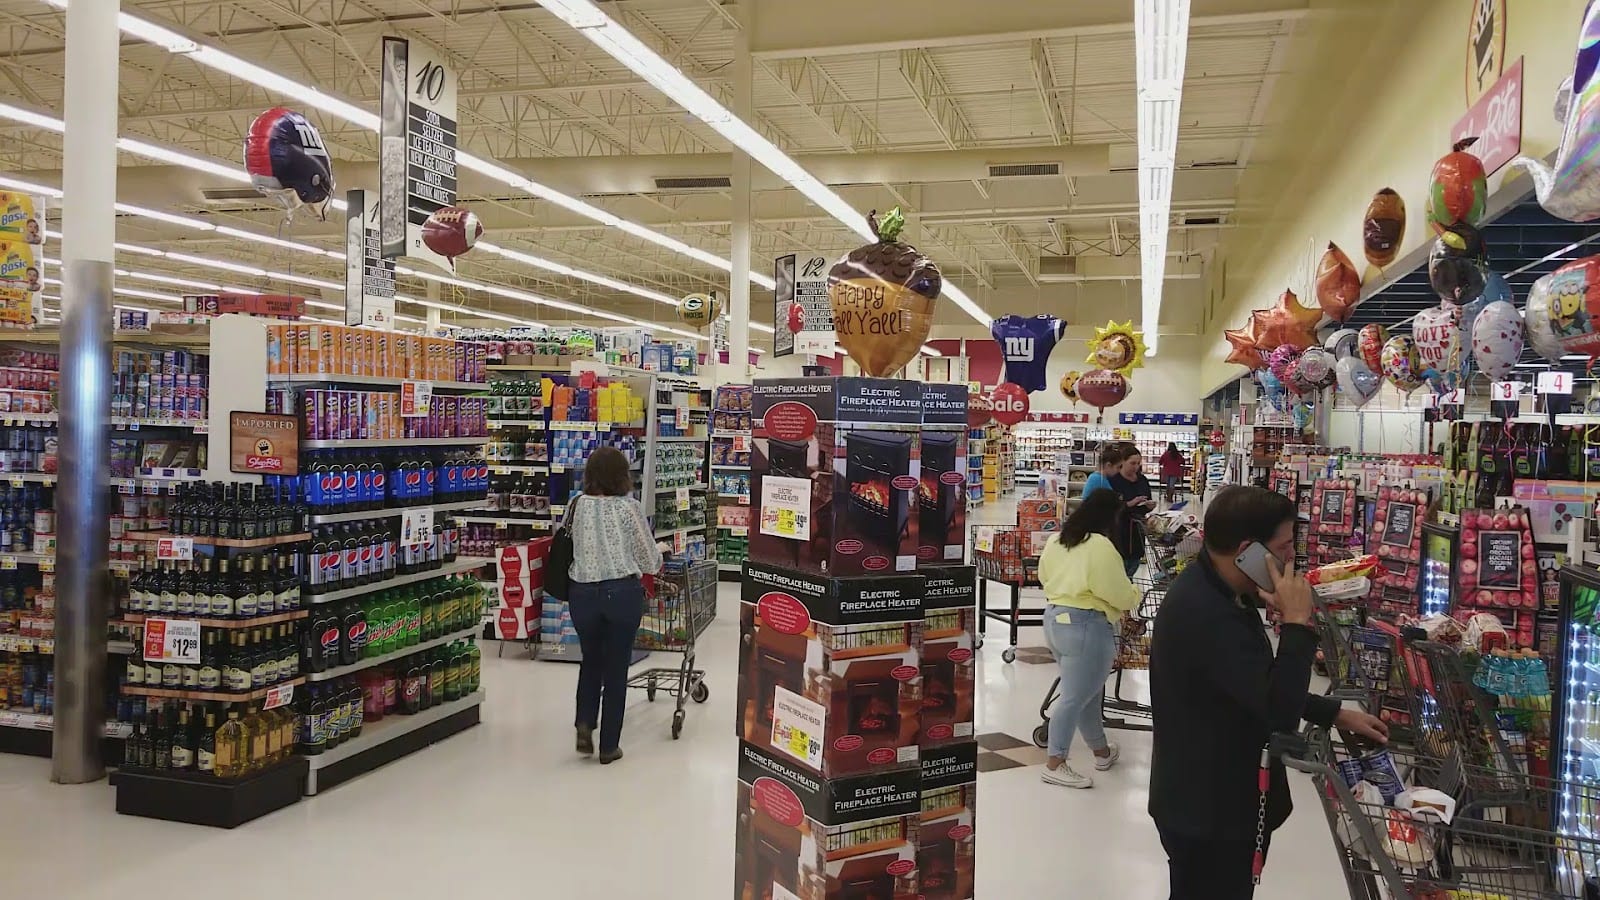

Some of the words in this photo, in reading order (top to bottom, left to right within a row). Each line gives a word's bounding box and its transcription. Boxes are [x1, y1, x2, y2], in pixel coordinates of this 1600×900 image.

[416, 61, 445, 101] 10
[426, 110, 440, 126] SODA
[422, 124, 444, 144] SELTZER
[422, 140, 432, 154] TEA
[433, 144, 452, 161] DRINKS
[410, 150, 423, 166] NEW
[424, 155, 435, 169] AGE
[436, 160, 454, 176] DRINKS
[424, 170, 442, 186] WATER
[416, 182, 433, 198] DRINK
[2, 213, 28, 226] Basic
[1, 261, 26, 275] Basic
[802, 256, 825, 277] 12
[837, 284, 885, 310] Happy
[855, 309, 902, 335] Y'all!
[1416, 324, 1450, 342] LOVE
[1005, 337, 1034, 362] ny
[1421, 346, 1442, 360] YOU
[808, 384, 832, 392] HEATER
[1554, 374, 1563, 392] 4
[860, 388, 900, 397] ELECTRIC
[1452, 390, 1458, 403] 2
[1504, 384, 1512, 398] 3
[841, 396, 887, 406] FIREPLACE
[985, 394, 1024, 412] Sale
[1432, 395, 1438, 406] 1
[236, 418, 294, 430] IMPORTED
[248, 457, 281, 469] ShopRite
[749, 568, 772, 580] ELECTRIC
[773, 573, 802, 588] FIREPLACE
[803, 580, 825, 594] HEATER
[860, 590, 900, 600] ELECTRIC
[943, 585, 972, 594] HEATER
[840, 600, 886, 610] FIREPLACE
[888, 598, 921, 607] HEATER
[745, 747, 768, 766] ELECTRIC
[768, 756, 798, 782] FIREPLACE
[797, 773, 820, 792] HEATER
[922, 756, 956, 768] ELECTRIC
[946, 762, 974, 773] HEATER
[855, 784, 896, 797] ELECTRIC
[834, 796, 880, 810] FIREPLACE
[883, 790, 917, 803] HEATER
